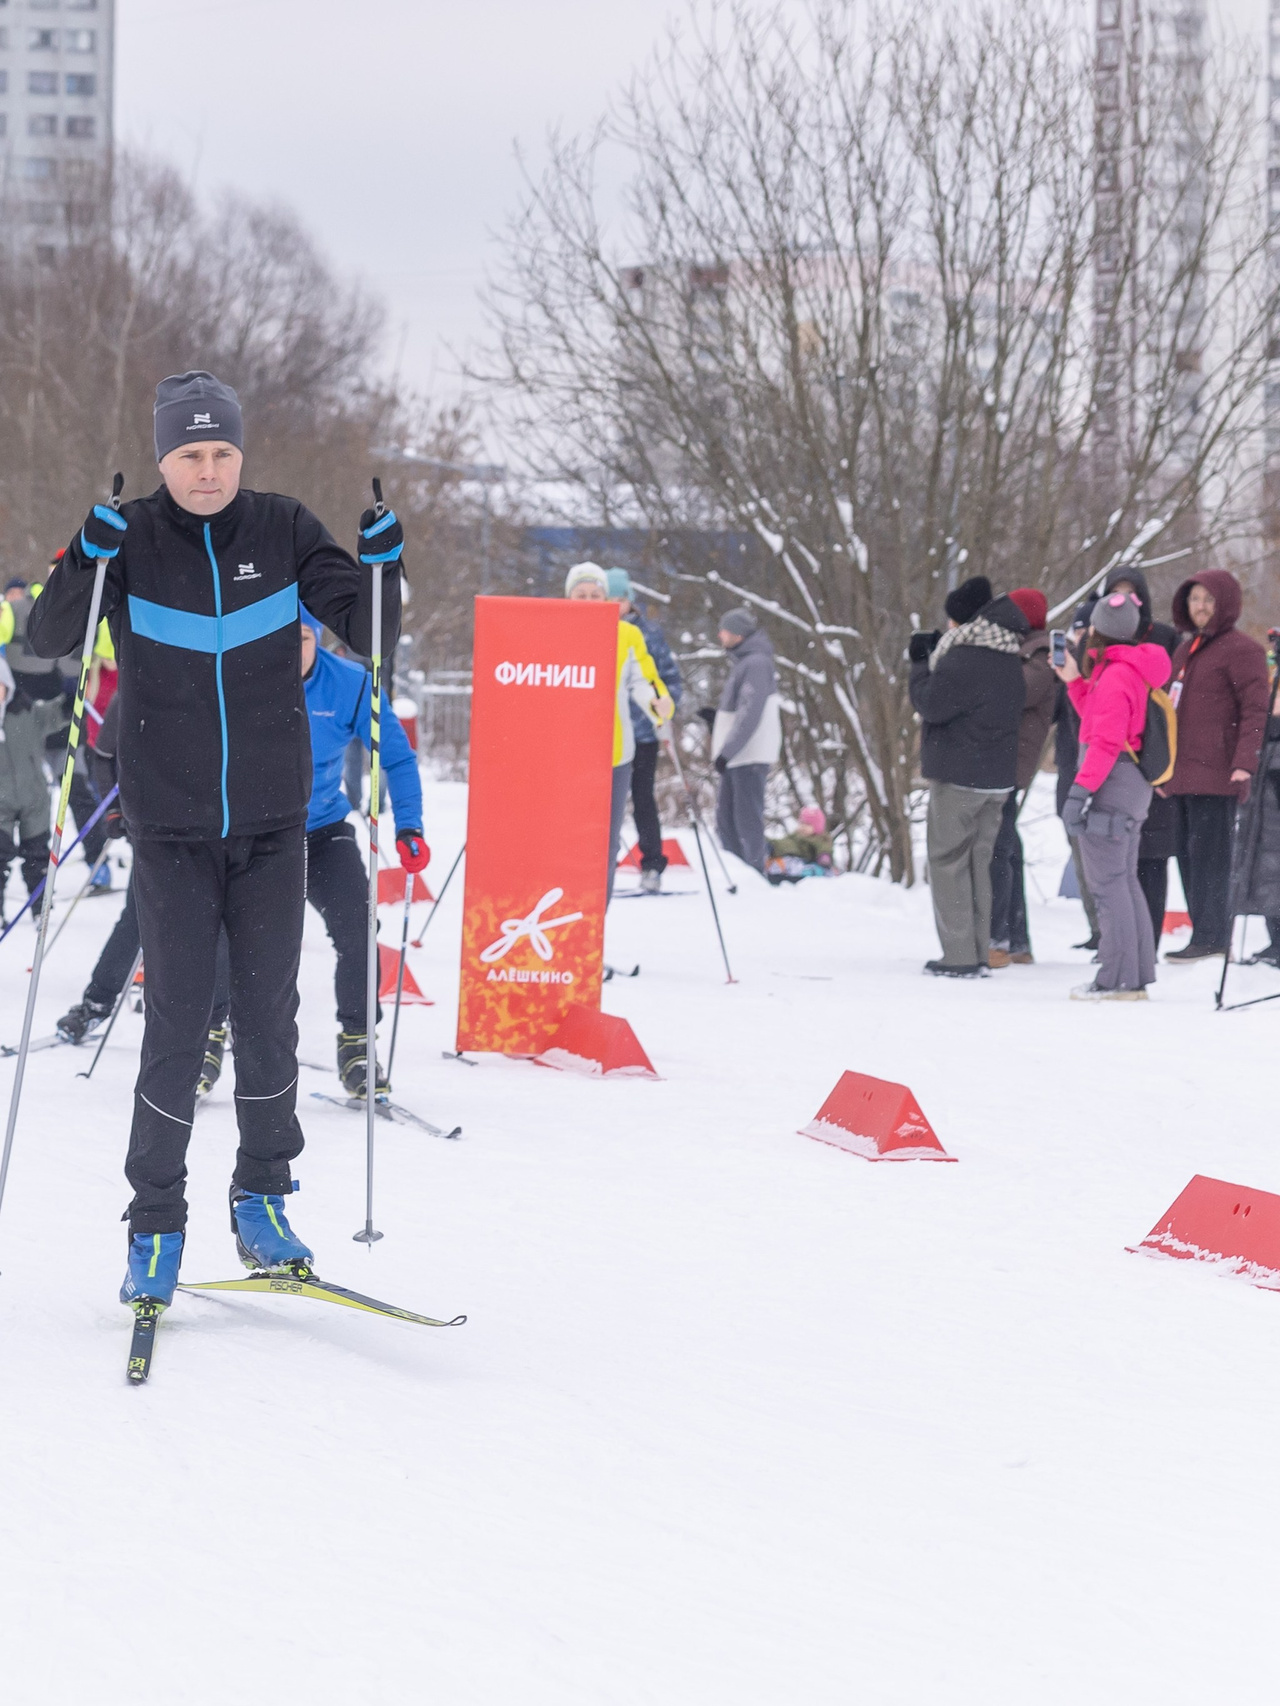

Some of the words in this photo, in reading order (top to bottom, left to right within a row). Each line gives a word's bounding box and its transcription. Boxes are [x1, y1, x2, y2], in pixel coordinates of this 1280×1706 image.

[494, 660, 596, 689] ФИНИШ
[486, 967, 574, 985] АЛЁШКИНО
[269, 1280, 303, 1293] FISCHER
